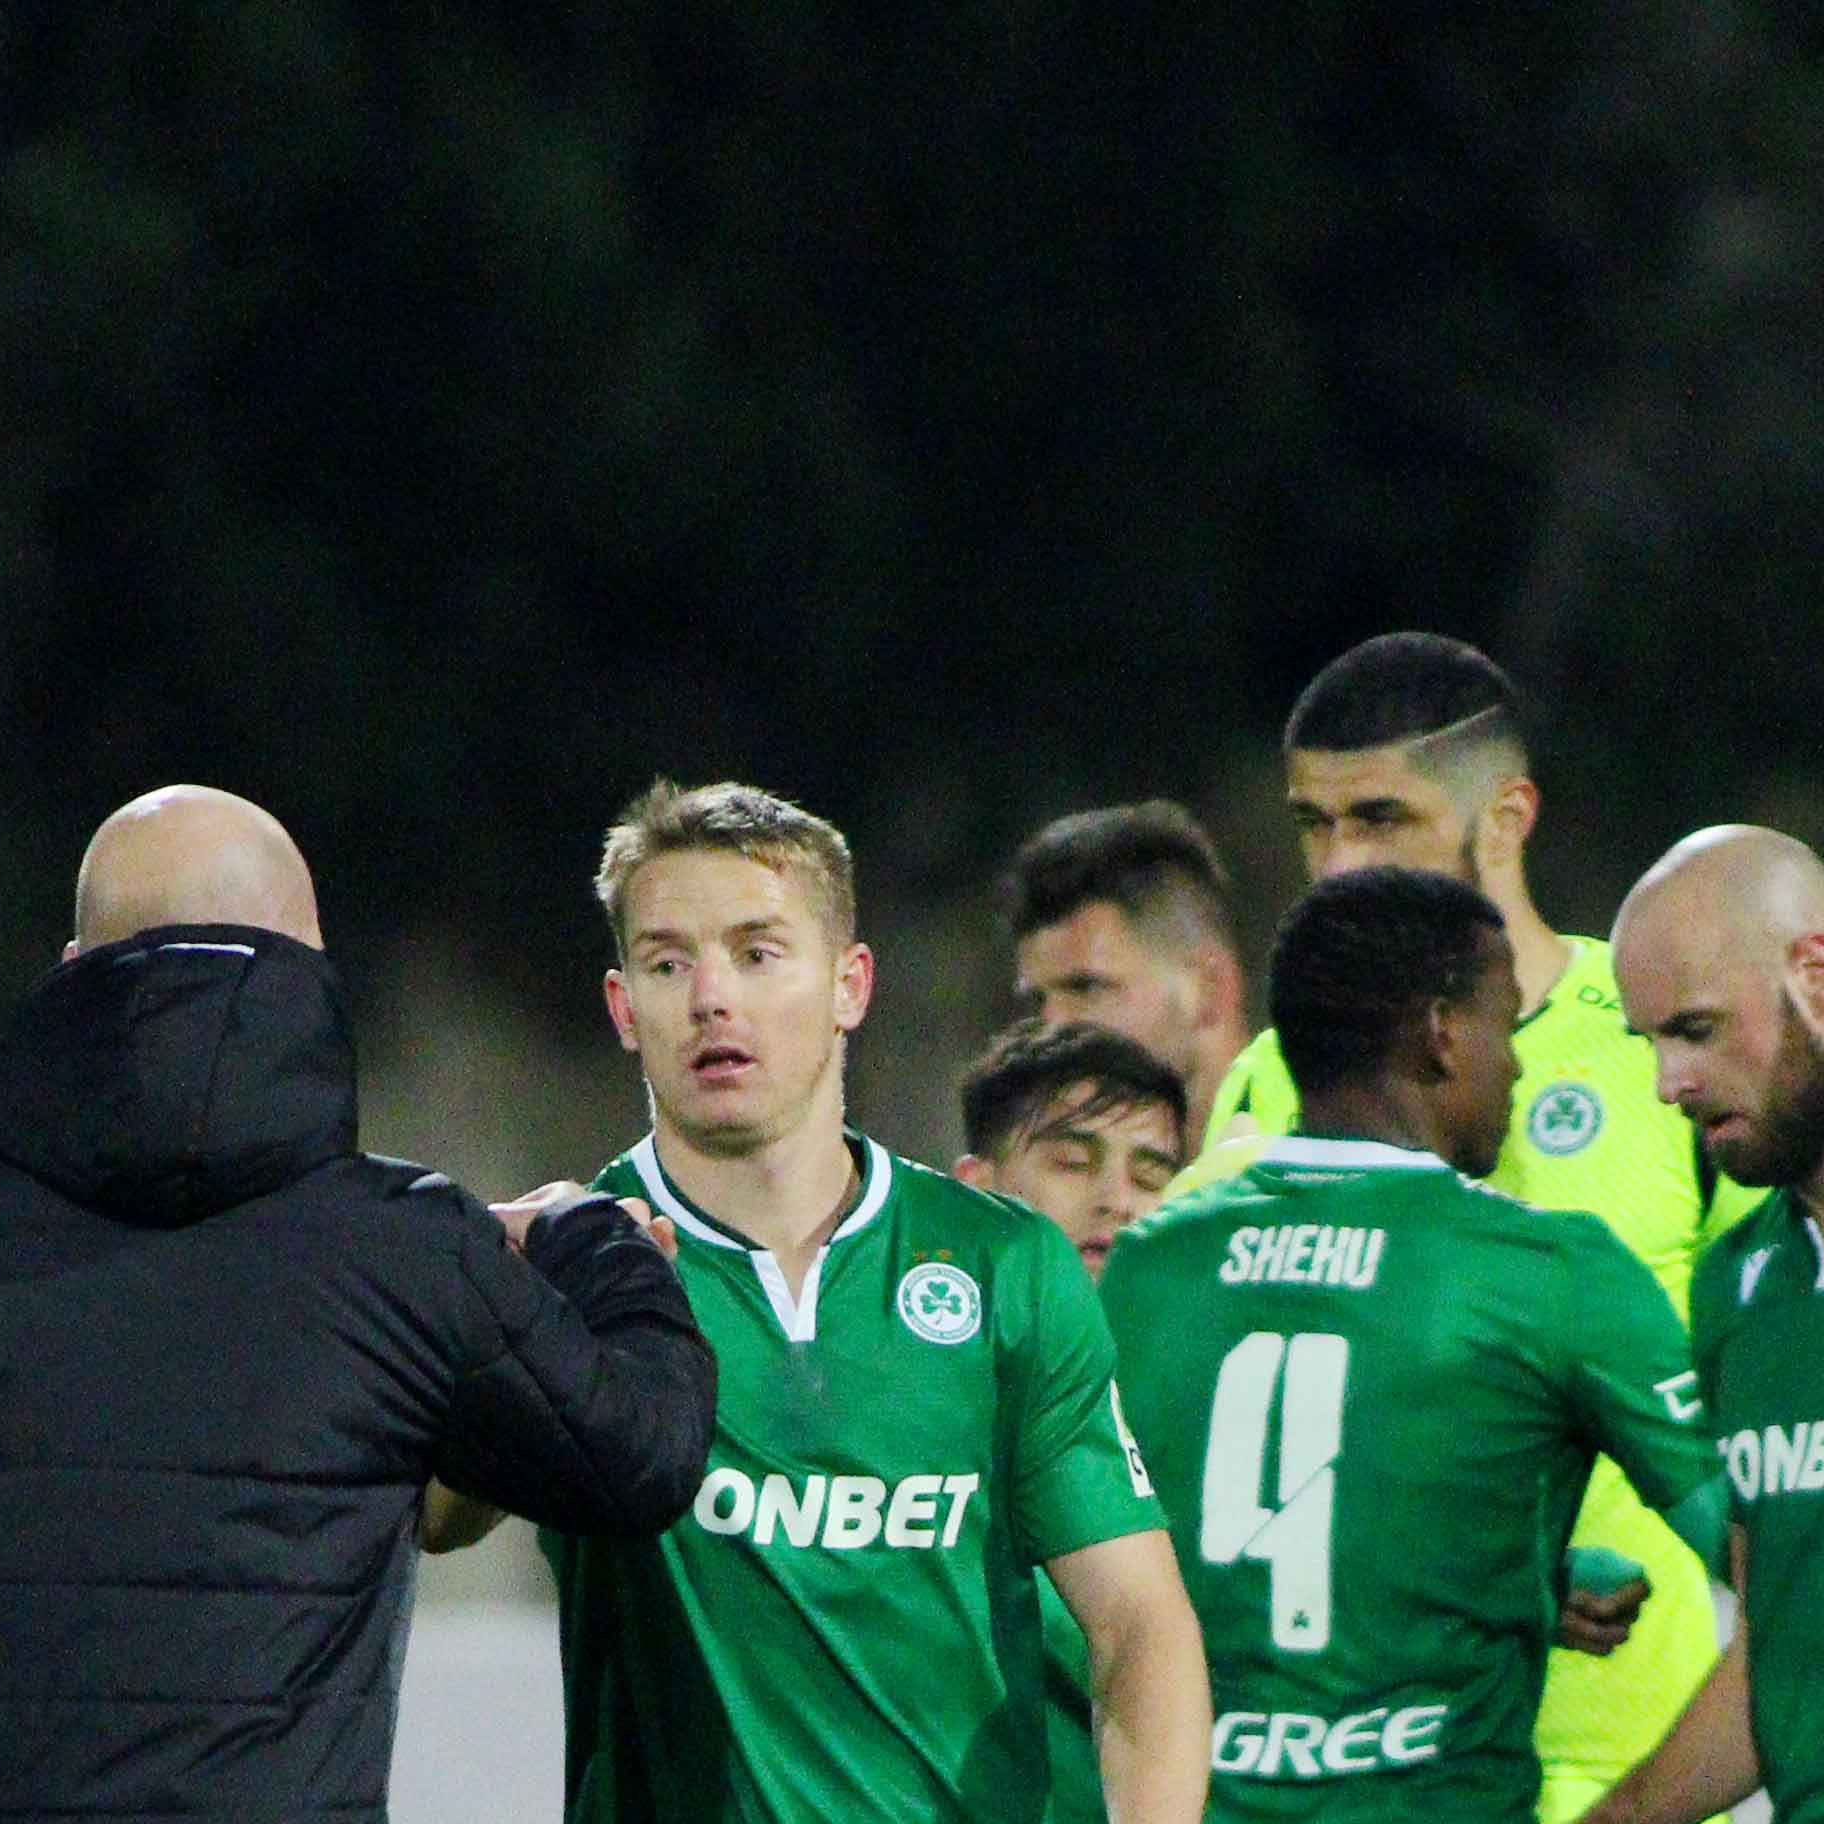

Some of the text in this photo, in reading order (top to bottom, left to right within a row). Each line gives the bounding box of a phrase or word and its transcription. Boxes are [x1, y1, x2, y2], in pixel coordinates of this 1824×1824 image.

[1219, 1222, 1387, 1289] SHEHU
[693, 1466, 980, 1550] ONBET
[1200, 1331, 1350, 1652] 4
[1210, 1704, 1449, 1777] GREE
